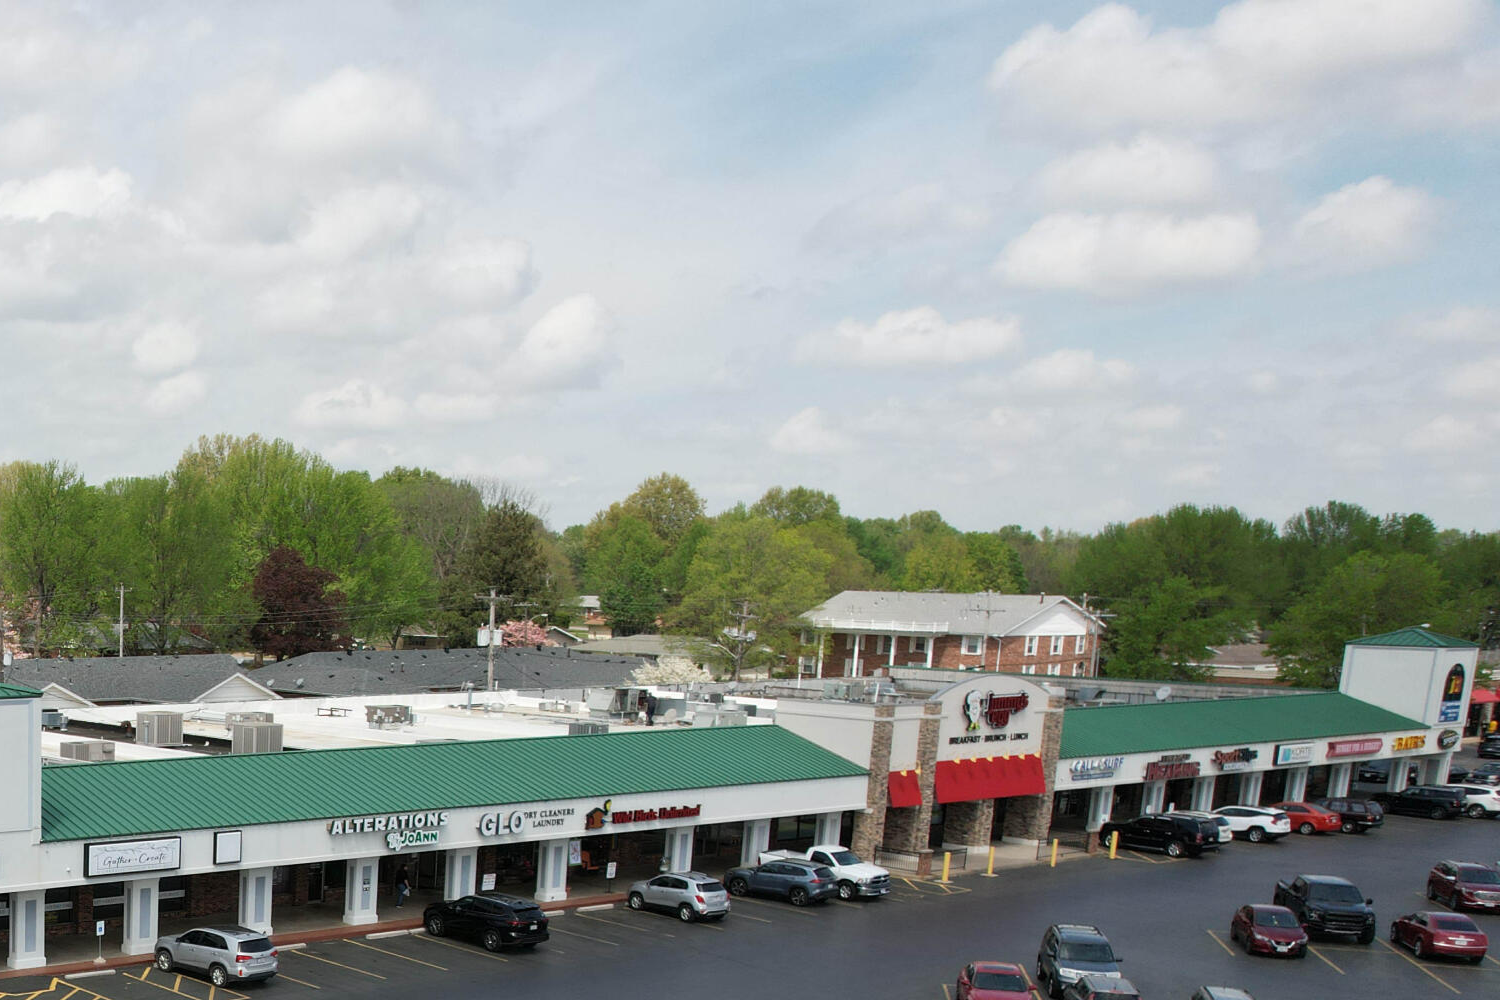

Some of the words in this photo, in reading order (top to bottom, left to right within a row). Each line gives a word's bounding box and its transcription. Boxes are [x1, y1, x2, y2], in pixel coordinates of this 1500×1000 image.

[949, 736, 981, 745] BREAKFAST
[984, 734, 1007, 742] BRUNCH
[1010, 733, 1029, 741] LUNCH
[524, 811, 537, 819] DRY
[540, 808, 575, 818] CLEANERS
[612, 811, 633, 824] Wild
[634, 809, 658, 821] Birds
[659, 804, 701, 819] Unlimited
[331, 812, 450, 835] ALTERATIONS
[481, 811, 524, 836] GLO
[533, 818, 564, 828] LAUNDRY
